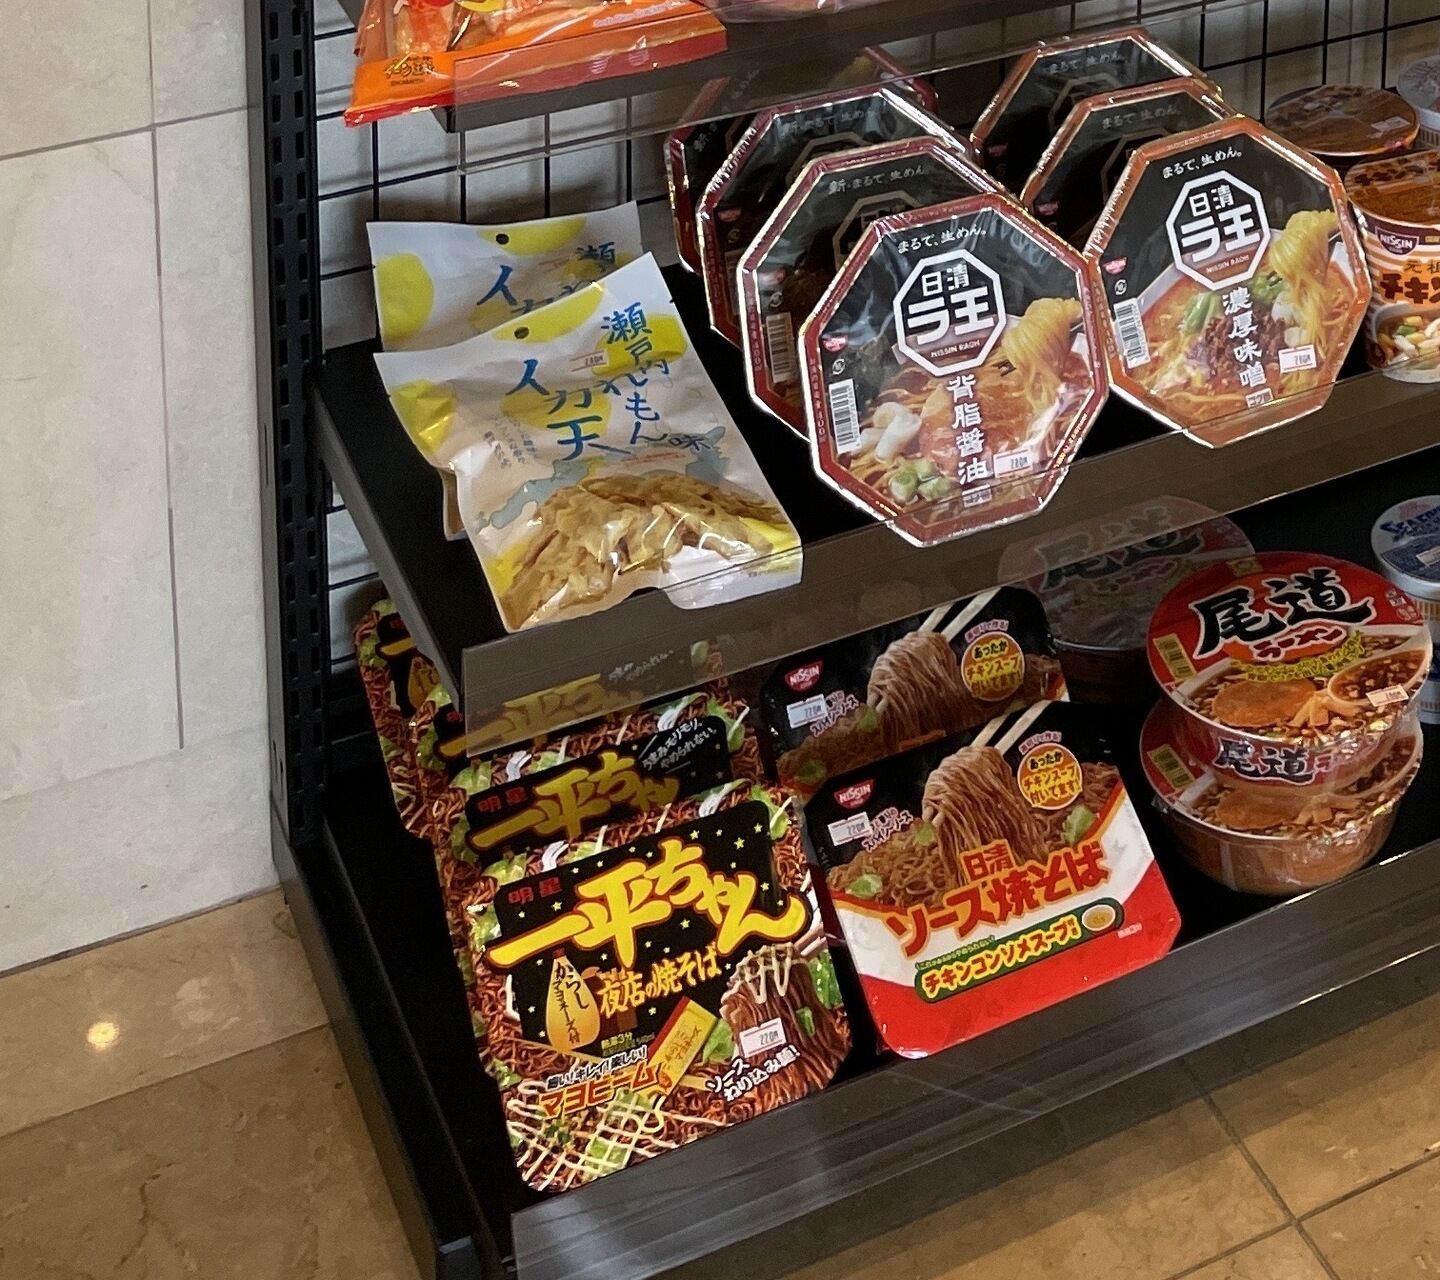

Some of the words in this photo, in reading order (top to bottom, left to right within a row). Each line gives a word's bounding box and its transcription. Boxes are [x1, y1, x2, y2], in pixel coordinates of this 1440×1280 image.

[1160, 149, 1243, 179] まるで、生めん。
[1188, 183, 1235, 217] 日清
[897, 226, 989, 256] まるで、生めん。
[1180, 203, 1261, 263] ラ王
[1379, 233, 1414, 250] NISSIN
[921, 263, 969, 293] 日清
[906, 294, 996, 344] ラ王
[1221, 283, 1266, 389] 濃厚味噌
[946, 374, 990, 487] 背脂醤油
[1192, 566, 1376, 659] 尾道
[970, 641, 1010, 658] あったか
[1252, 623, 1347, 661] ラーメン
[787, 667, 821, 687] NISSIN
[1022, 763, 1078, 791] チキンスープ
[1027, 750, 1064, 769] あったか
[1210, 735, 1318, 784] 尾道
[836, 783, 873, 804] NISSIN
[965, 845, 1015, 880] 日清
[487, 837, 808, 969] 一平ちゃん
[508, 876, 562, 905] 明星
[885, 840, 1111, 959] ソース焼そば
[598, 946, 723, 1016] 夜店の焼そば
[539, 1060, 657, 1118] マヨビーム
[706, 1057, 750, 1093] ソース
